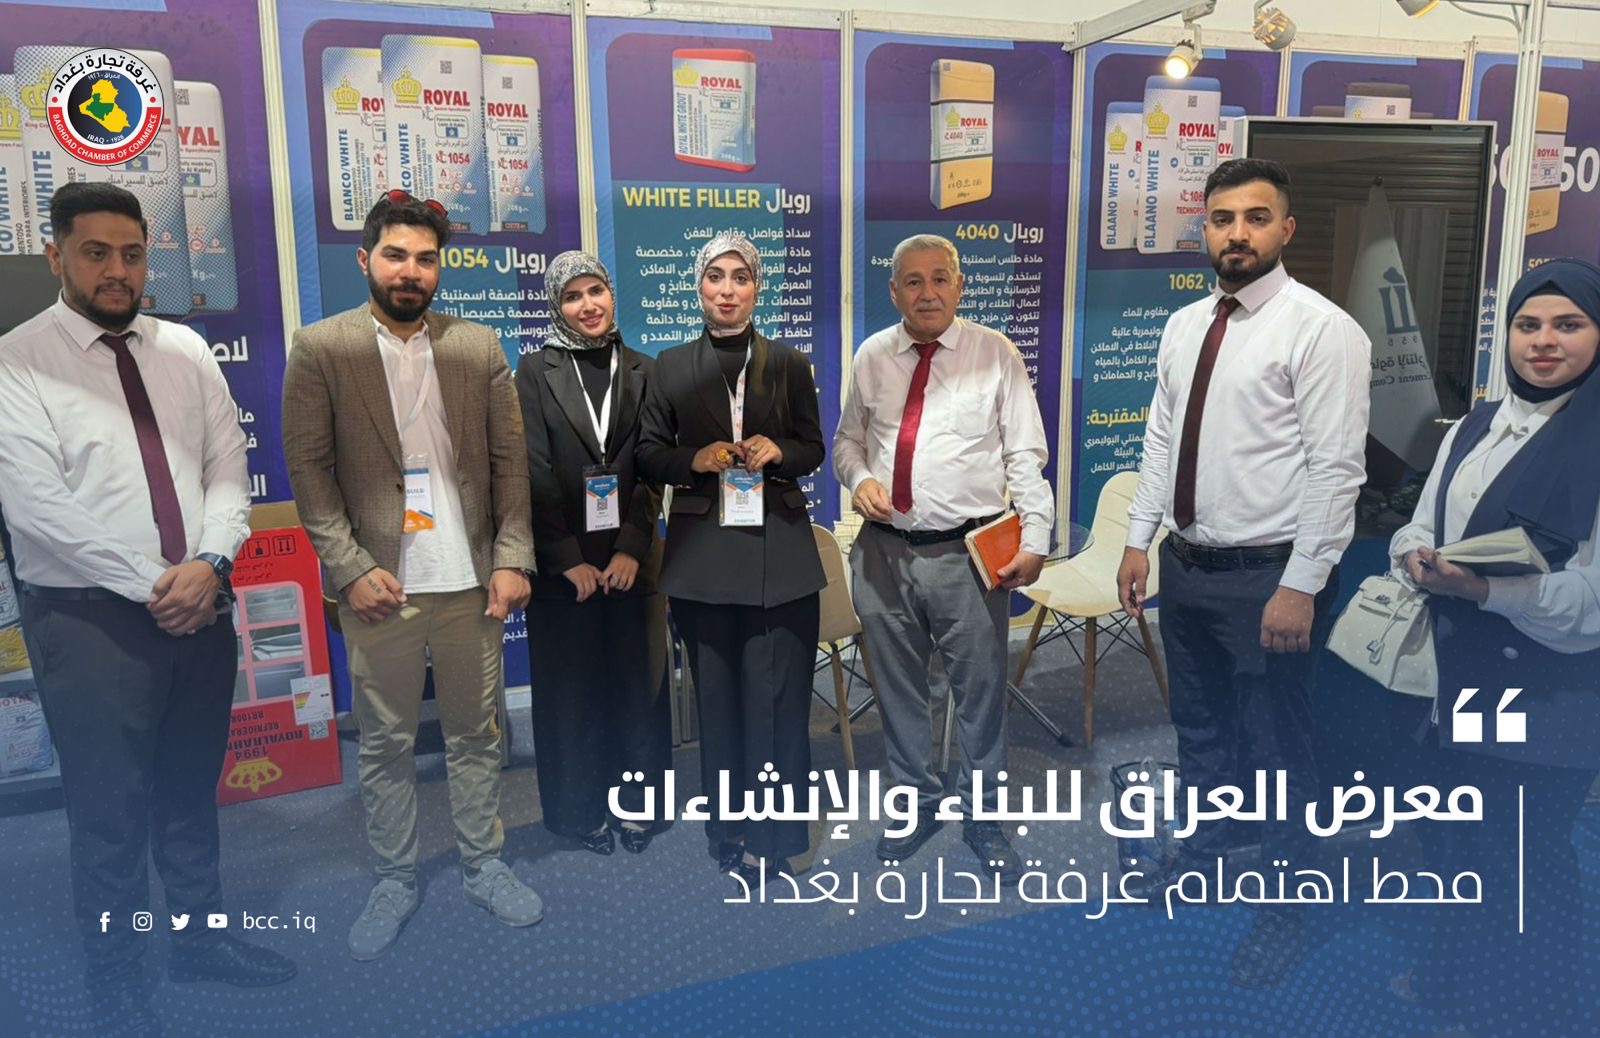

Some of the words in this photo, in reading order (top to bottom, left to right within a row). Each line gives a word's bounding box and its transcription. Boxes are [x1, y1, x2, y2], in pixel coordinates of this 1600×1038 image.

[700, 76, 742, 89] ROYAL
[423, 89, 471, 107] ROYAL
[487, 102, 529, 118] ROYAL
[960, 117, 988, 127] ROYAL
[1179, 122, 1216, 137] ROYAL
[447, 152, 471, 164] 1054
[1536, 148, 1559, 158] ROYAL
[509, 159, 529, 170] 1054
[1146, 150, 1160, 192] WHITE
[338, 128, 353, 221] BLANCO/WHITE
[1108, 163, 1119, 198] WHITE
[622, 186, 691, 208] WHITE
[697, 188, 761, 209] FILLER
[765, 188, 811, 214] رويال
[1190, 191, 1204, 202] 106
[1106, 201, 1117, 245] BLAANO
[1144, 196, 1157, 248] BLAANO
[683, 227, 713, 240] للعفن
[748, 227, 784, 240] فواصل
[785, 227, 811, 238] سداد
[955, 224, 999, 240] 4040
[1004, 223, 1044, 243] رويال
[440, 247, 489, 268] 1054
[635, 245, 683, 257] مخصصة
[789, 246, 811, 257] مادة
[494, 247, 546, 274] رويال
[961, 254, 997, 266] اسمنتية
[1023, 253, 1043, 263] مادة
[640, 263, 675, 277] الاماكن
[678, 263, 694, 279] في
[1006, 272, 1042, 284] تستخدم
[1168, 273, 1204, 290] 1062
[441, 288, 486, 303] اسمنتية
[488, 289, 525, 301] لاصقة
[1003, 285, 1041, 296] الخرسانية
[641, 297, 680, 310] مقاومة
[771, 295, 812, 306] الحمامات
[1016, 299, 1040, 309] اعمال
[763, 311, 790, 325] العفن
[792, 311, 812, 325] لنمو
[980, 312, 999, 324] مزيج
[1001, 312, 1014, 322] من
[1016, 311, 1040, 322] تتكون
[1122, 307, 1142, 317] للماء
[1144, 306, 1169, 319] مقاوم
[649, 330, 682, 342] التمدد
[766, 327, 783, 340] على
[785, 327, 812, 338] تحافظ
[211, 336, 249, 362] لاص
[1090, 342, 1118, 353] الاماكن
[1120, 342, 1133, 355] في
[1122, 355, 1147, 367] الكامل
[1100, 370, 1136, 380] الحمامات
[229, 721, 279, 737] REFRIGERA
[235, 746, 269, 761] 1994
